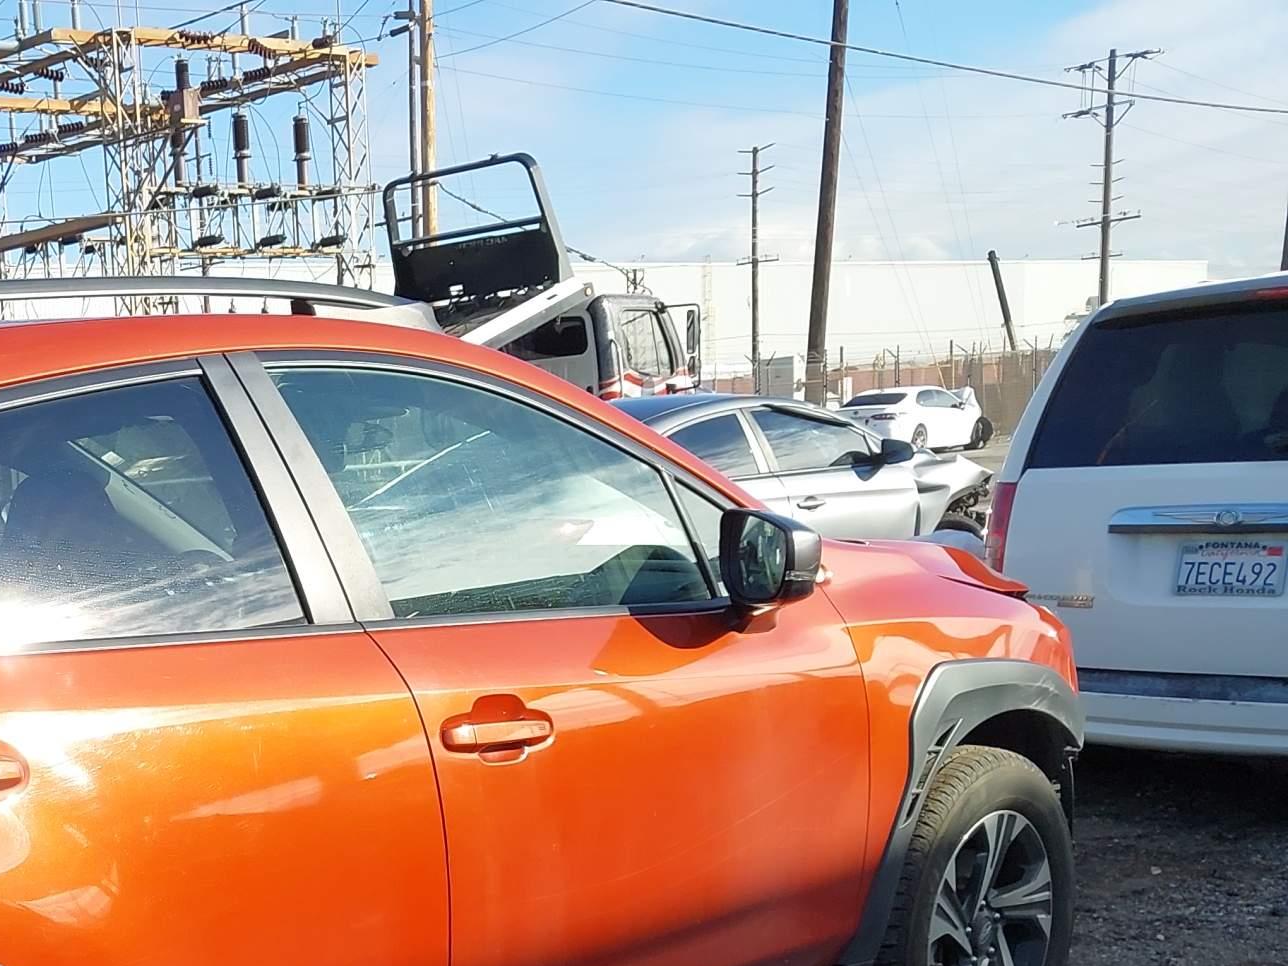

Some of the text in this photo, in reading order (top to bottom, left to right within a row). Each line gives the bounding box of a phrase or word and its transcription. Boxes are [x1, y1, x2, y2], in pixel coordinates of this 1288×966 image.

[1205, 541, 1261, 550] FONTANA
[1183, 561, 1277, 587] 7ECE492
[1177, 585, 1276, 595] Rock Honda
